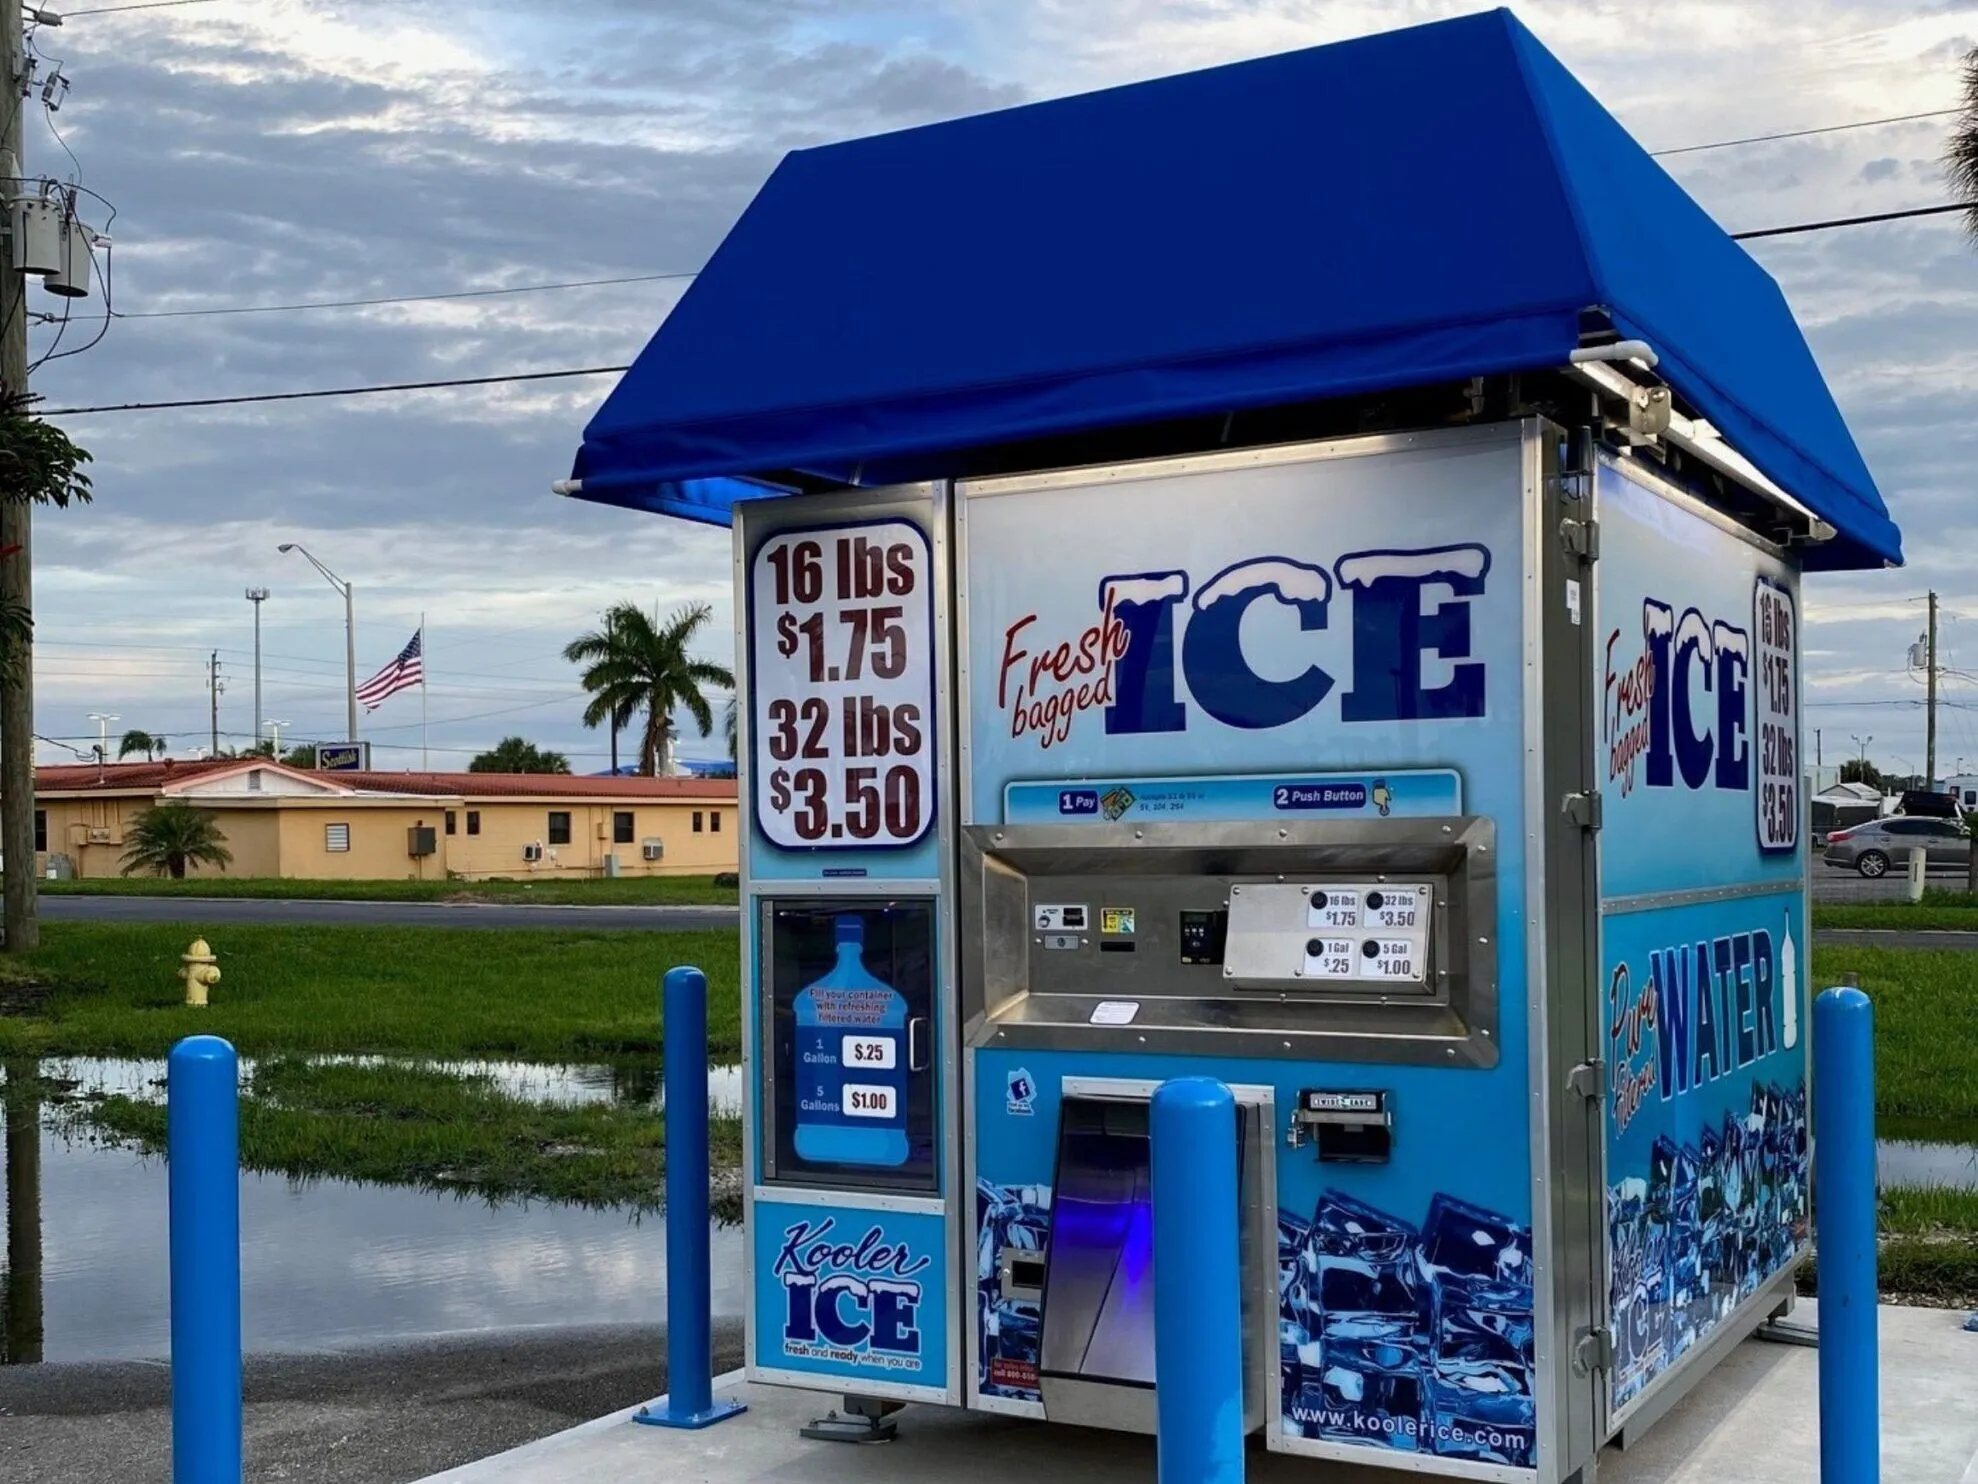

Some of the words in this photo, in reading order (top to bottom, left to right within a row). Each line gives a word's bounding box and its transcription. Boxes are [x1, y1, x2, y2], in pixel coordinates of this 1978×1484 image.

[767, 541, 823, 605] 16
[837, 537, 915, 601] lbs
[1758, 592, 1773, 646] 16
[1773, 597, 1791, 652] lbs
[777, 606, 907, 683] $1.75
[999, 586, 1130, 708] Fresh
[1099, 542, 1492, 735] ICE
[1604, 610, 1656, 744] Fresh
[1763, 651, 1790, 717] $1.75
[1012, 660, 1114, 749] bagged
[1643, 596, 1749, 791] ICE
[768, 697, 830, 761] 32
[842, 695, 922, 758] lbs
[1609, 713, 1648, 799] bagged
[1763, 722, 1776, 776] 32
[1777, 728, 1794, 779] lbs
[770, 764, 920, 840] $3.50
[1063, 794, 1073, 809] 1
[1076, 795, 1096, 810] Pay
[1276, 788, 1289, 804] 2
[1292, 790, 1320, 803] Push
[1324, 789, 1364, 802] Button
[1763, 781, 1794, 844] $3.50
[1329, 895, 1340, 906] 16
[1341, 895, 1356, 906] lbs
[1384, 895, 1397, 906] 32
[1398, 896, 1413, 906] lbs
[1326, 911, 1356, 927] $1.75
[1380, 911, 1415, 927] $3.50
[1328, 943, 1333, 953] 1
[1334, 942, 1349, 954] Gal
[1383, 943, 1391, 955] 5
[1392, 943, 1407, 955] Gal
[1324, 957, 1349, 974] $.25
[1377, 959, 1411, 975] $1.00
[826, 990, 846, 1001] your
[848, 991, 892, 1000] container
[816, 1002, 835, 1011] with
[838, 1003, 885, 1014] refreshing
[855, 1015, 880, 1024] water
[1649, 928, 1777, 1102] WATER
[816, 1039, 823, 1049] 1
[855, 1043, 884, 1061] $.25
[803, 1052, 837, 1064] Gallon
[816, 1085, 824, 1096] 5
[851, 1090, 887, 1110] $1.00
[801, 1099, 840, 1112] Gallons
[774, 1218, 930, 1276] Kooler
[784, 1272, 921, 1353] ICE
[785, 1342, 810, 1356] fresh
[811, 1346, 828, 1358] and
[829, 1348, 859, 1363] ready
[861, 1353, 884, 1364] when
[886, 1355, 904, 1368] you
[904, 1357, 920, 1369] are
[1292, 1407, 1526, 1449] www.koolerice.com
